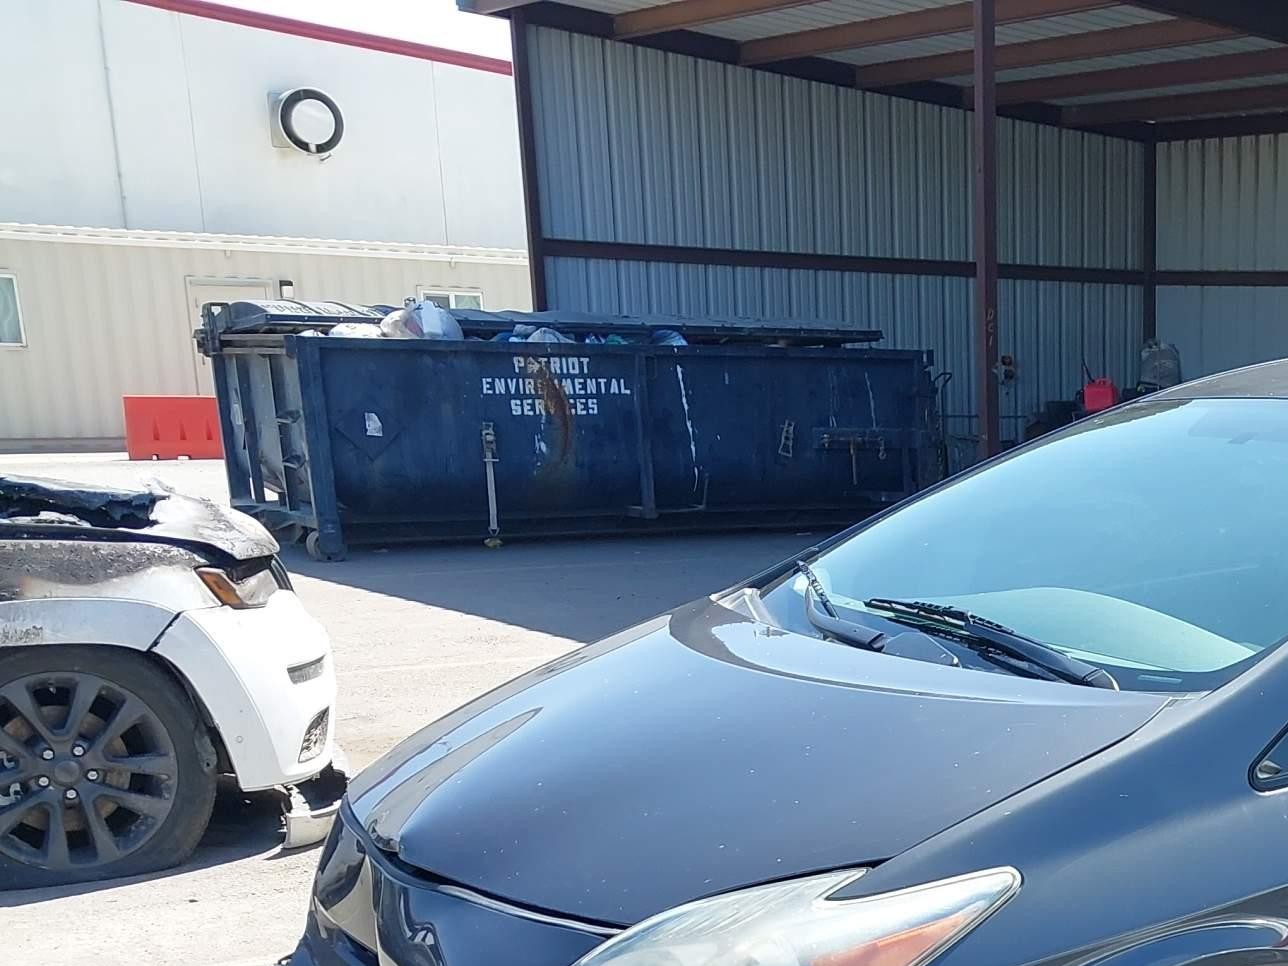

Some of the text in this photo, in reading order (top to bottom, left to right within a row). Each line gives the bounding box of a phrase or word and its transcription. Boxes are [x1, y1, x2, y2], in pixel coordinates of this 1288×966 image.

[513, 356, 590, 374] PATRIOT
[482, 378, 631, 395] ENVIROMENTAL
[510, 398, 599, 416] SERVCES
